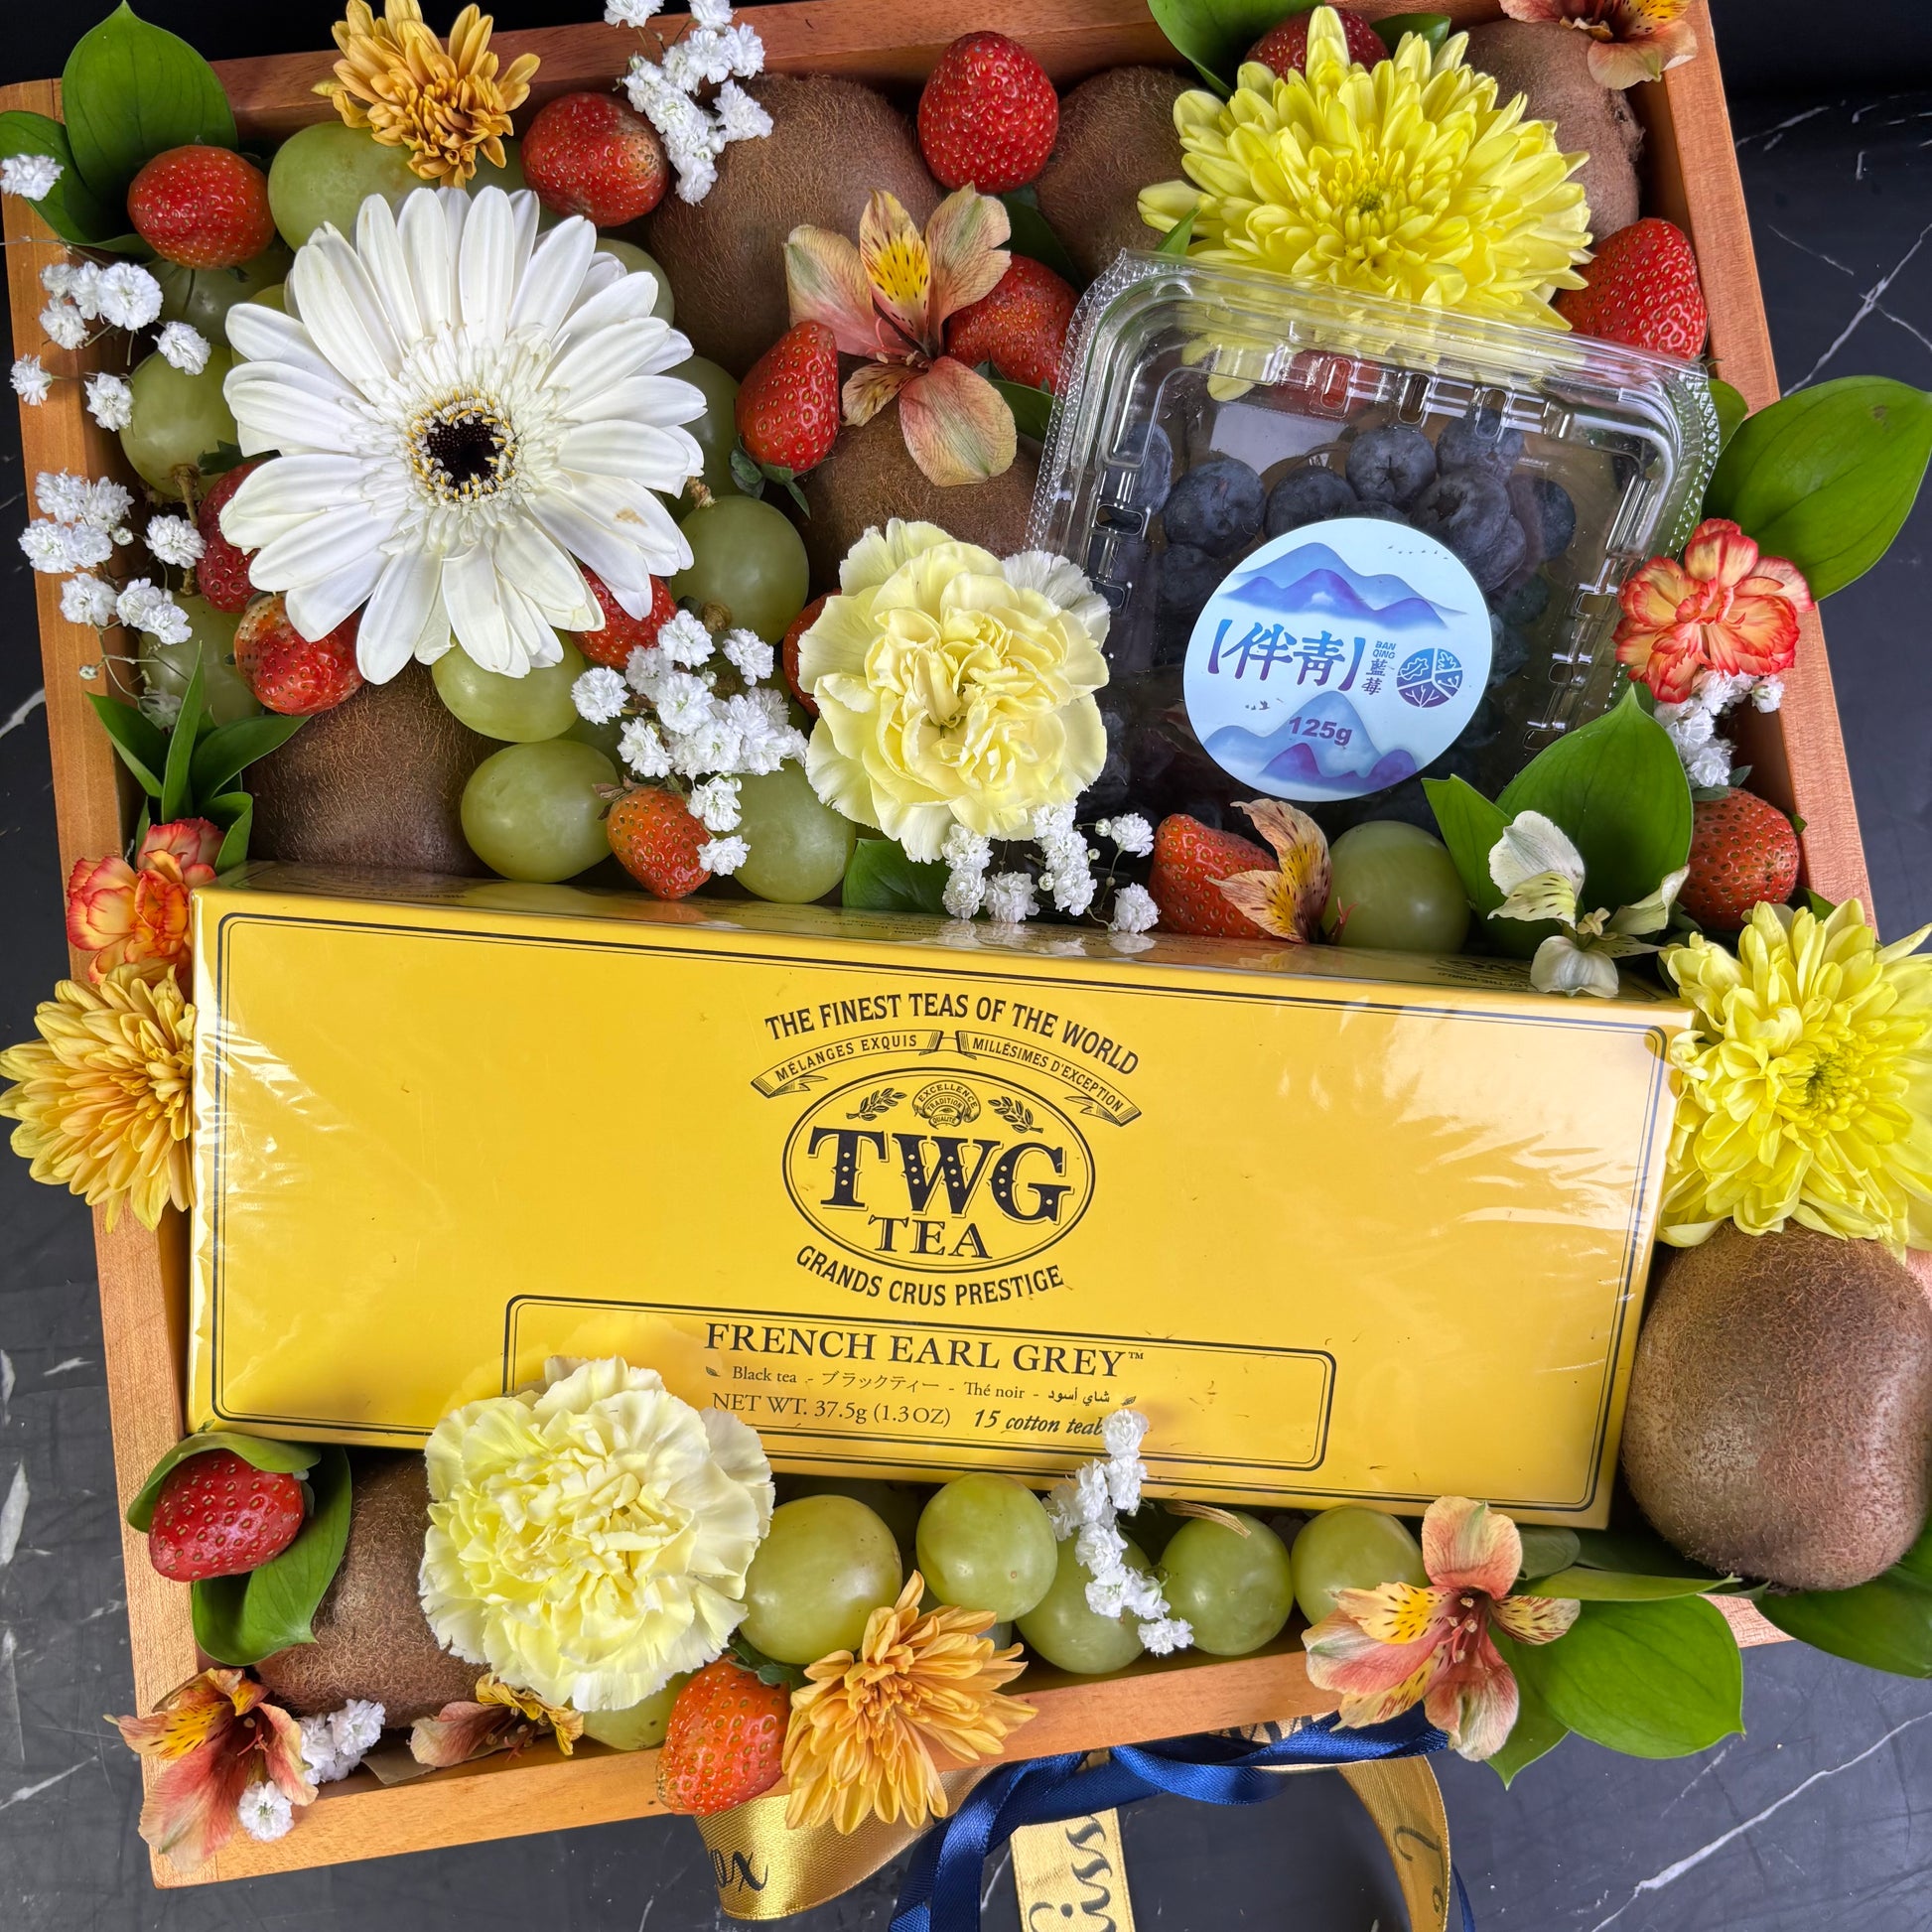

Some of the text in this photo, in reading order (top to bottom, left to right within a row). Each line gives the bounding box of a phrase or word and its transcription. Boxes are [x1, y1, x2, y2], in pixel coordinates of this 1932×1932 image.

[1375, 640, 1397, 651] BAN
[1288, 716, 1353, 747] 125g
[764, 993, 1140, 1076] THE FINEST TEAS OF THE WORLD
[774, 1034, 918, 1082] MÉLANGES EXQUIS
[972, 1036, 1125, 1113] MILLÉSIMES D'EXCEPTION
[917, 1083, 978, 1109] EXCELLENCE
[927, 1097, 963, 1112] TRADITION
[808, 1126, 1075, 1226] TWG
[867, 1214, 993, 1260] TEA
[796, 1244, 1065, 1307] GRANDS CRUS PRESTIGE
[704, 1322, 877, 1361] FRENCH
[888, 1335, 1000, 1370] EARL
[733, 1365, 772, 1383] Black
[776, 1372, 797, 1384] tea
[822, 1370, 939, 1394] ブラックティー
[964, 1381, 991, 1397] Thé
[995, 1387, 1026, 1400] noir
[1082, 1390, 1110, 1407] شاي
[713, 1393, 761, 1412] NET
[766, 1396, 808, 1416] WT.
[814, 1400, 868, 1425] 37.5g
[974, 1408, 1103, 1436] 15 cotton teab
